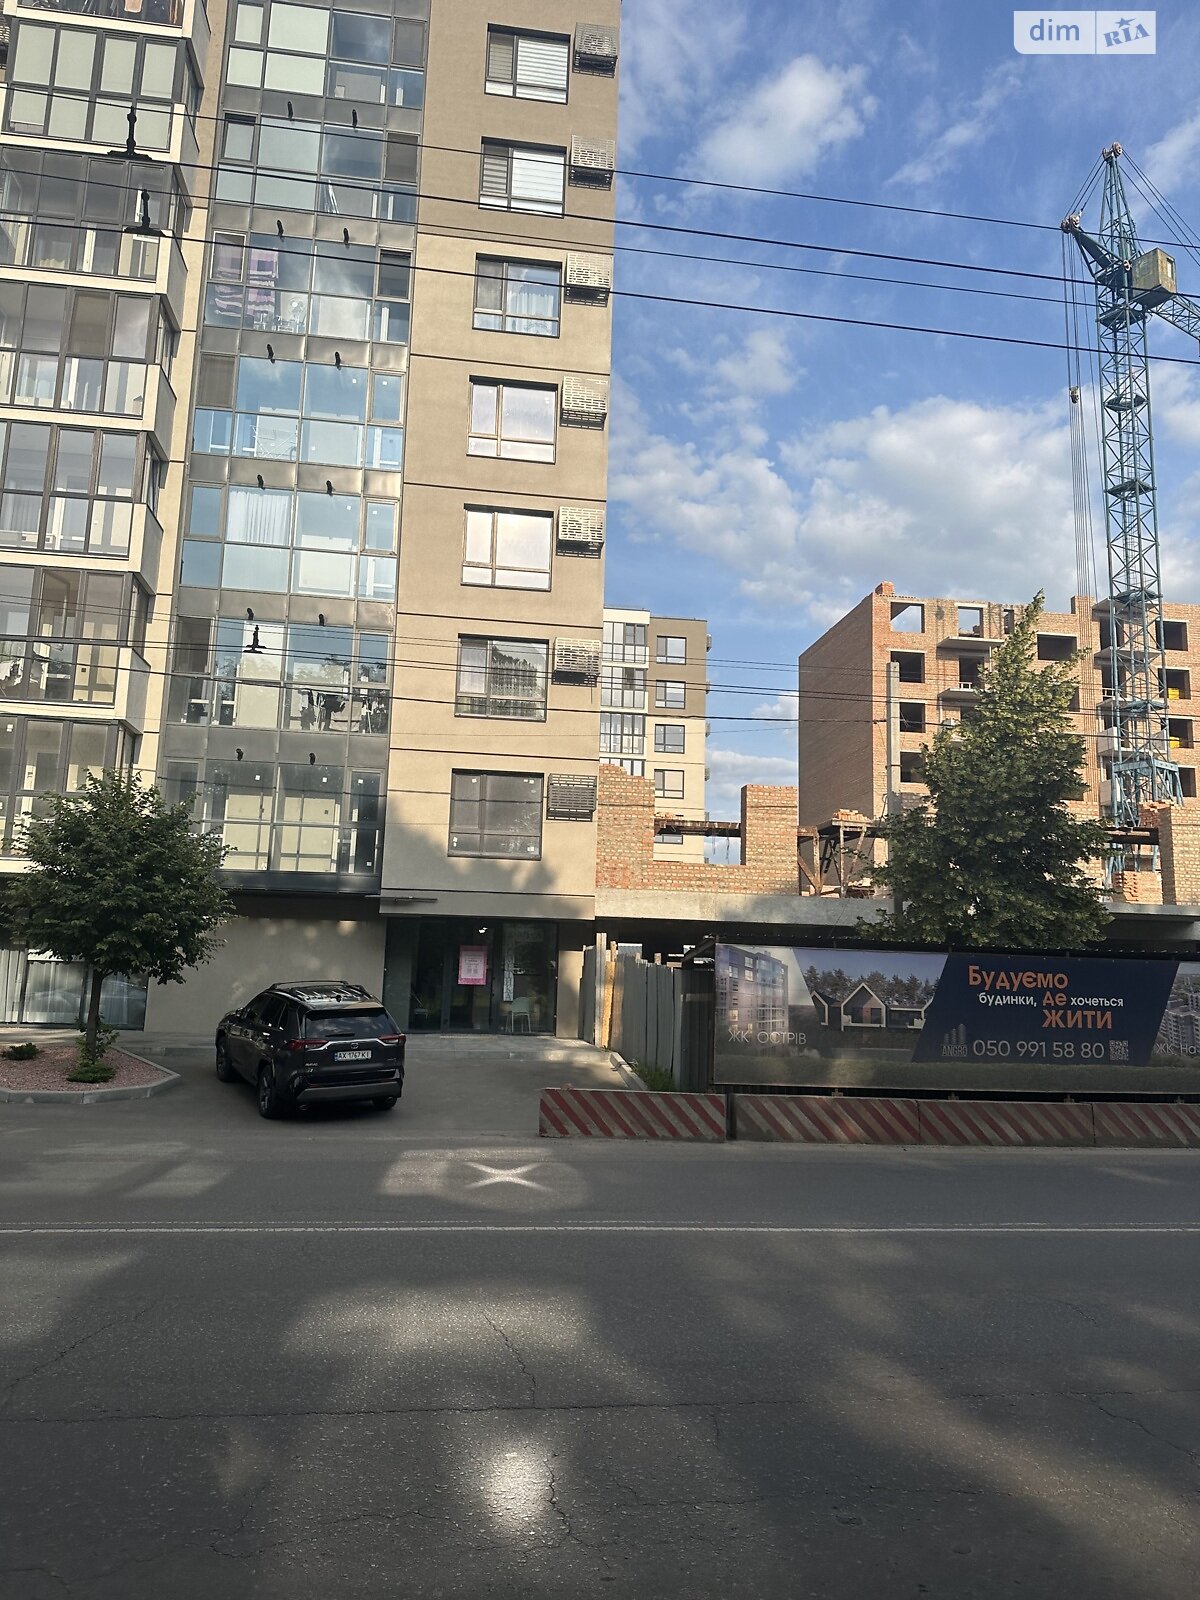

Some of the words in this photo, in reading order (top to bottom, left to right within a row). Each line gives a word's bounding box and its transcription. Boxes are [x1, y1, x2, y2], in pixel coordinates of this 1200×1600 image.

[968, 965, 1069, 991] Будуємо
[978, 992, 1037, 1008] будинки,
[1070, 995, 1124, 1007] хочеться
[1042, 1009, 1113, 1030] ЖИТИ
[728, 1029, 750, 1043] ЖК
[757, 1031, 807, 1045] ОСТРІВ
[972, 1039, 1011, 1057] 050
[1016, 1041, 1047, 1058] 991
[1052, 1042, 1075, 1059] 58
[1081, 1042, 1105, 1059] 80
[1155, 1043, 1174, 1055] ЖК
